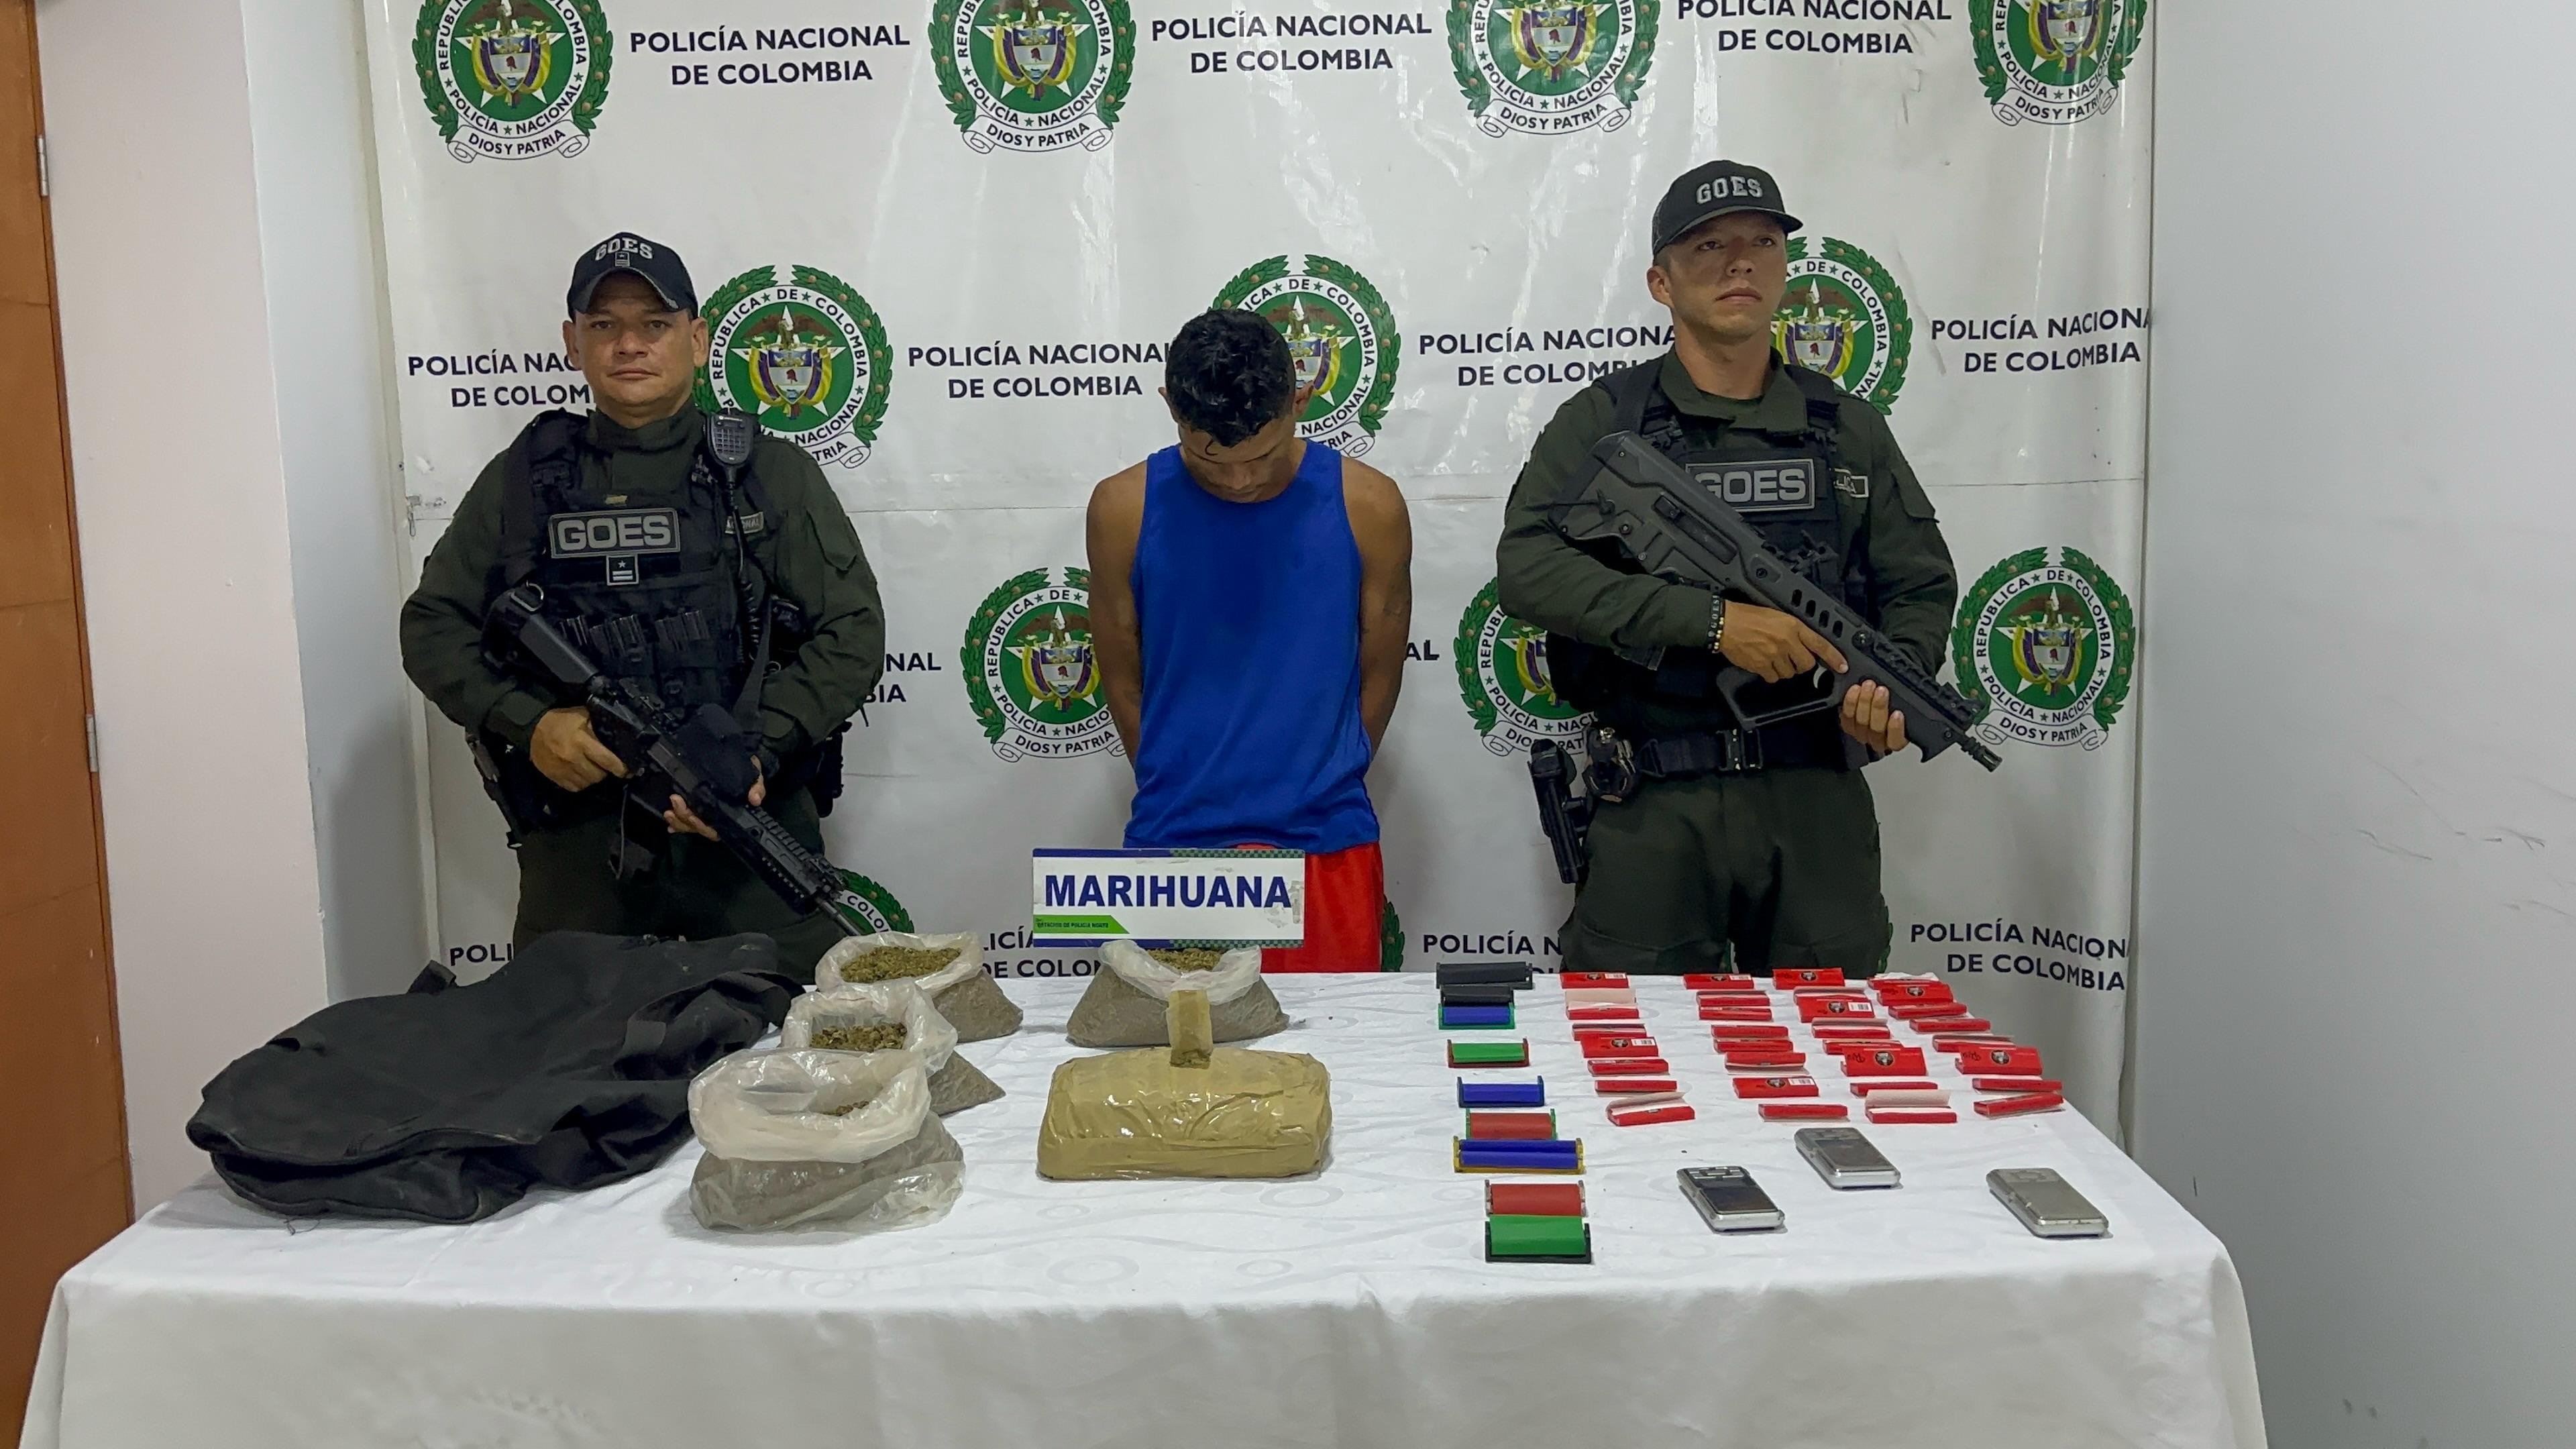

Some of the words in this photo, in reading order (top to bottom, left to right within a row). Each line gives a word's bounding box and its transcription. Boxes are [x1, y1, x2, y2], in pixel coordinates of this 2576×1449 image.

[1803, 0, 1951, 20] NACIONAL
[550, 0, 587, 64] LOMBIA
[631, 25, 747, 52] POLICÍA
[756, 24, 910, 50] NACIONAL
[1085, 0, 1112, 56] OMBIA
[1152, 11, 1267, 41] POLICÍA
[1276, 13, 1432, 37] NACIONAL
[1718, 29, 1756, 51] DE
[1766, 30, 1913, 53] COLOMBIA
[672, 64, 708, 85] DE
[718, 60, 872, 85] COLOMBIA
[1191, 51, 1227, 73] DE
[1236, 48, 1393, 71] COLOMBIA
[2069, 38, 2113, 99] NACIONAL
[1554, 54, 1625, 109] NACIONAL
[516, 83, 582, 135] NACIONAL
[1038, 76, 1106, 127] NACIONAL
[2068, 89, 2104, 119] PATRIA
[1554, 103, 1607, 129] PATRIA
[517, 129, 566, 154] PATRIA
[1038, 123, 1090, 147] PATRIA
[1696, 176, 1763, 204] GOES
[594, 237, 653, 261] GOES
[1807, 261, 1826, 272] DE
[1841, 270, 1886, 351] COLOMBIA
[777, 288, 798, 300] DE
[815, 297, 867, 378] COLOMBIA
[1289, 279, 1310, 290] DE
[1327, 286, 1375, 367] COLOMBIA
[1931, 314, 2038, 340] POLICÍA
[2047, 307, 2149, 338] NACION
[908, 341, 1021, 367] POLICÍA
[1419, 327, 1535, 355] POLICÍA
[1543, 325, 1675, 351] NACIONA
[408, 349, 517, 376] POLICÍA
[1964, 353, 1997, 372] DE
[2006, 341, 2141, 371] COLOMBIA
[948, 378, 985, 398] DE
[993, 375, 1142, 397] COLOMBIA
[1458, 366, 1494, 386] DE
[1503, 360, 1637, 384] COLOM
[451, 388, 487, 407] DE
[494, 384, 590, 407] COLOM
[794, 396, 863, 444] NACIONAL
[1301, 385, 1368, 435] NACIONAL
[812, 441, 848, 462] TRIA
[557, 515, 671, 551] GOES
[1050, 590, 1069, 600] DE
[2047, 570, 2064, 581] DE
[2076, 579, 2111, 659] COLOMBIA
[2052, 678, 2102, 722] NACIONAL
[1065, 710, 1110, 736] NACIO
[1558, 714, 1595, 732] NACI
[2051, 722, 2088, 741] PATRIA
[1066, 731, 1114, 753] PATRIA
[1505, 729, 1532, 748] DIO
[1044, 875, 1292, 908] MARIHUANA
[847, 896, 889, 932] COLO
[1423, 930, 1535, 955] POLICÍA
[1911, 918, 2024, 943] POLICÍA
[2032, 926, 2128, 959] NACION
[450, 943, 512, 966] POLI
[1017, 959, 1101, 977] COLO
[1947, 954, 1982, 973] DE
[1992, 954, 2125, 991] COLOMBIA
